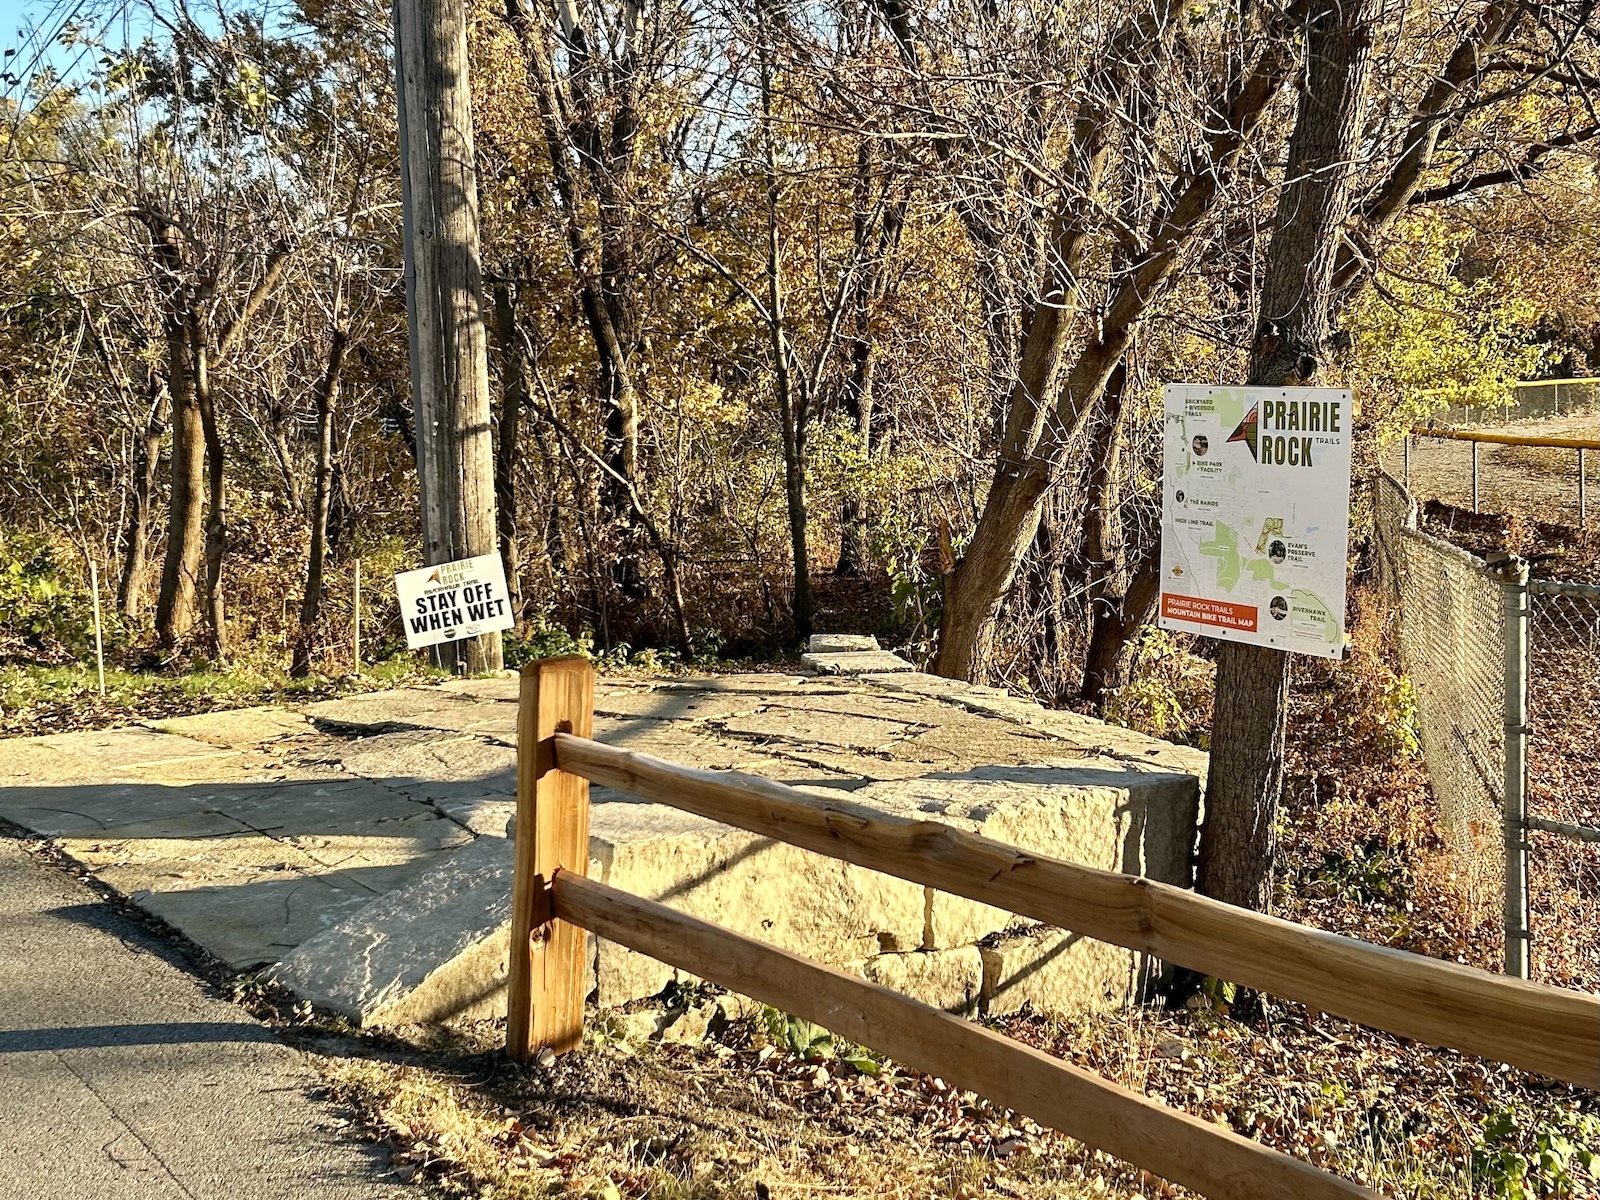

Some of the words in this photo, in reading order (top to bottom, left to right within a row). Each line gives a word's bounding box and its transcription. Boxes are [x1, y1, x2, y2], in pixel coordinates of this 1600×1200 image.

[1263, 401, 1340, 432] PRAIRIE
[1262, 436, 1312, 466] ROCK
[441, 560, 474, 574] PRAIRIE
[442, 573, 465, 584] ROCK
[416, 590, 457, 614] STAY
[463, 582, 493, 604] OFF
[1168, 598, 1191, 608] PRAIRIE
[1193, 601, 1210, 611] ROCK
[1212, 604, 1233, 614] TRAILS
[410, 608, 463, 634] WHEN
[467, 599, 504, 622] WET
[1167, 608, 1200, 618] MOUNTAIN
[1202, 613, 1217, 621] BIKE
[1218, 615, 1236, 624] TRAIL
[1238, 618, 1253, 627] MAP
[1293, 607, 1326, 616] RIVERHAWK
